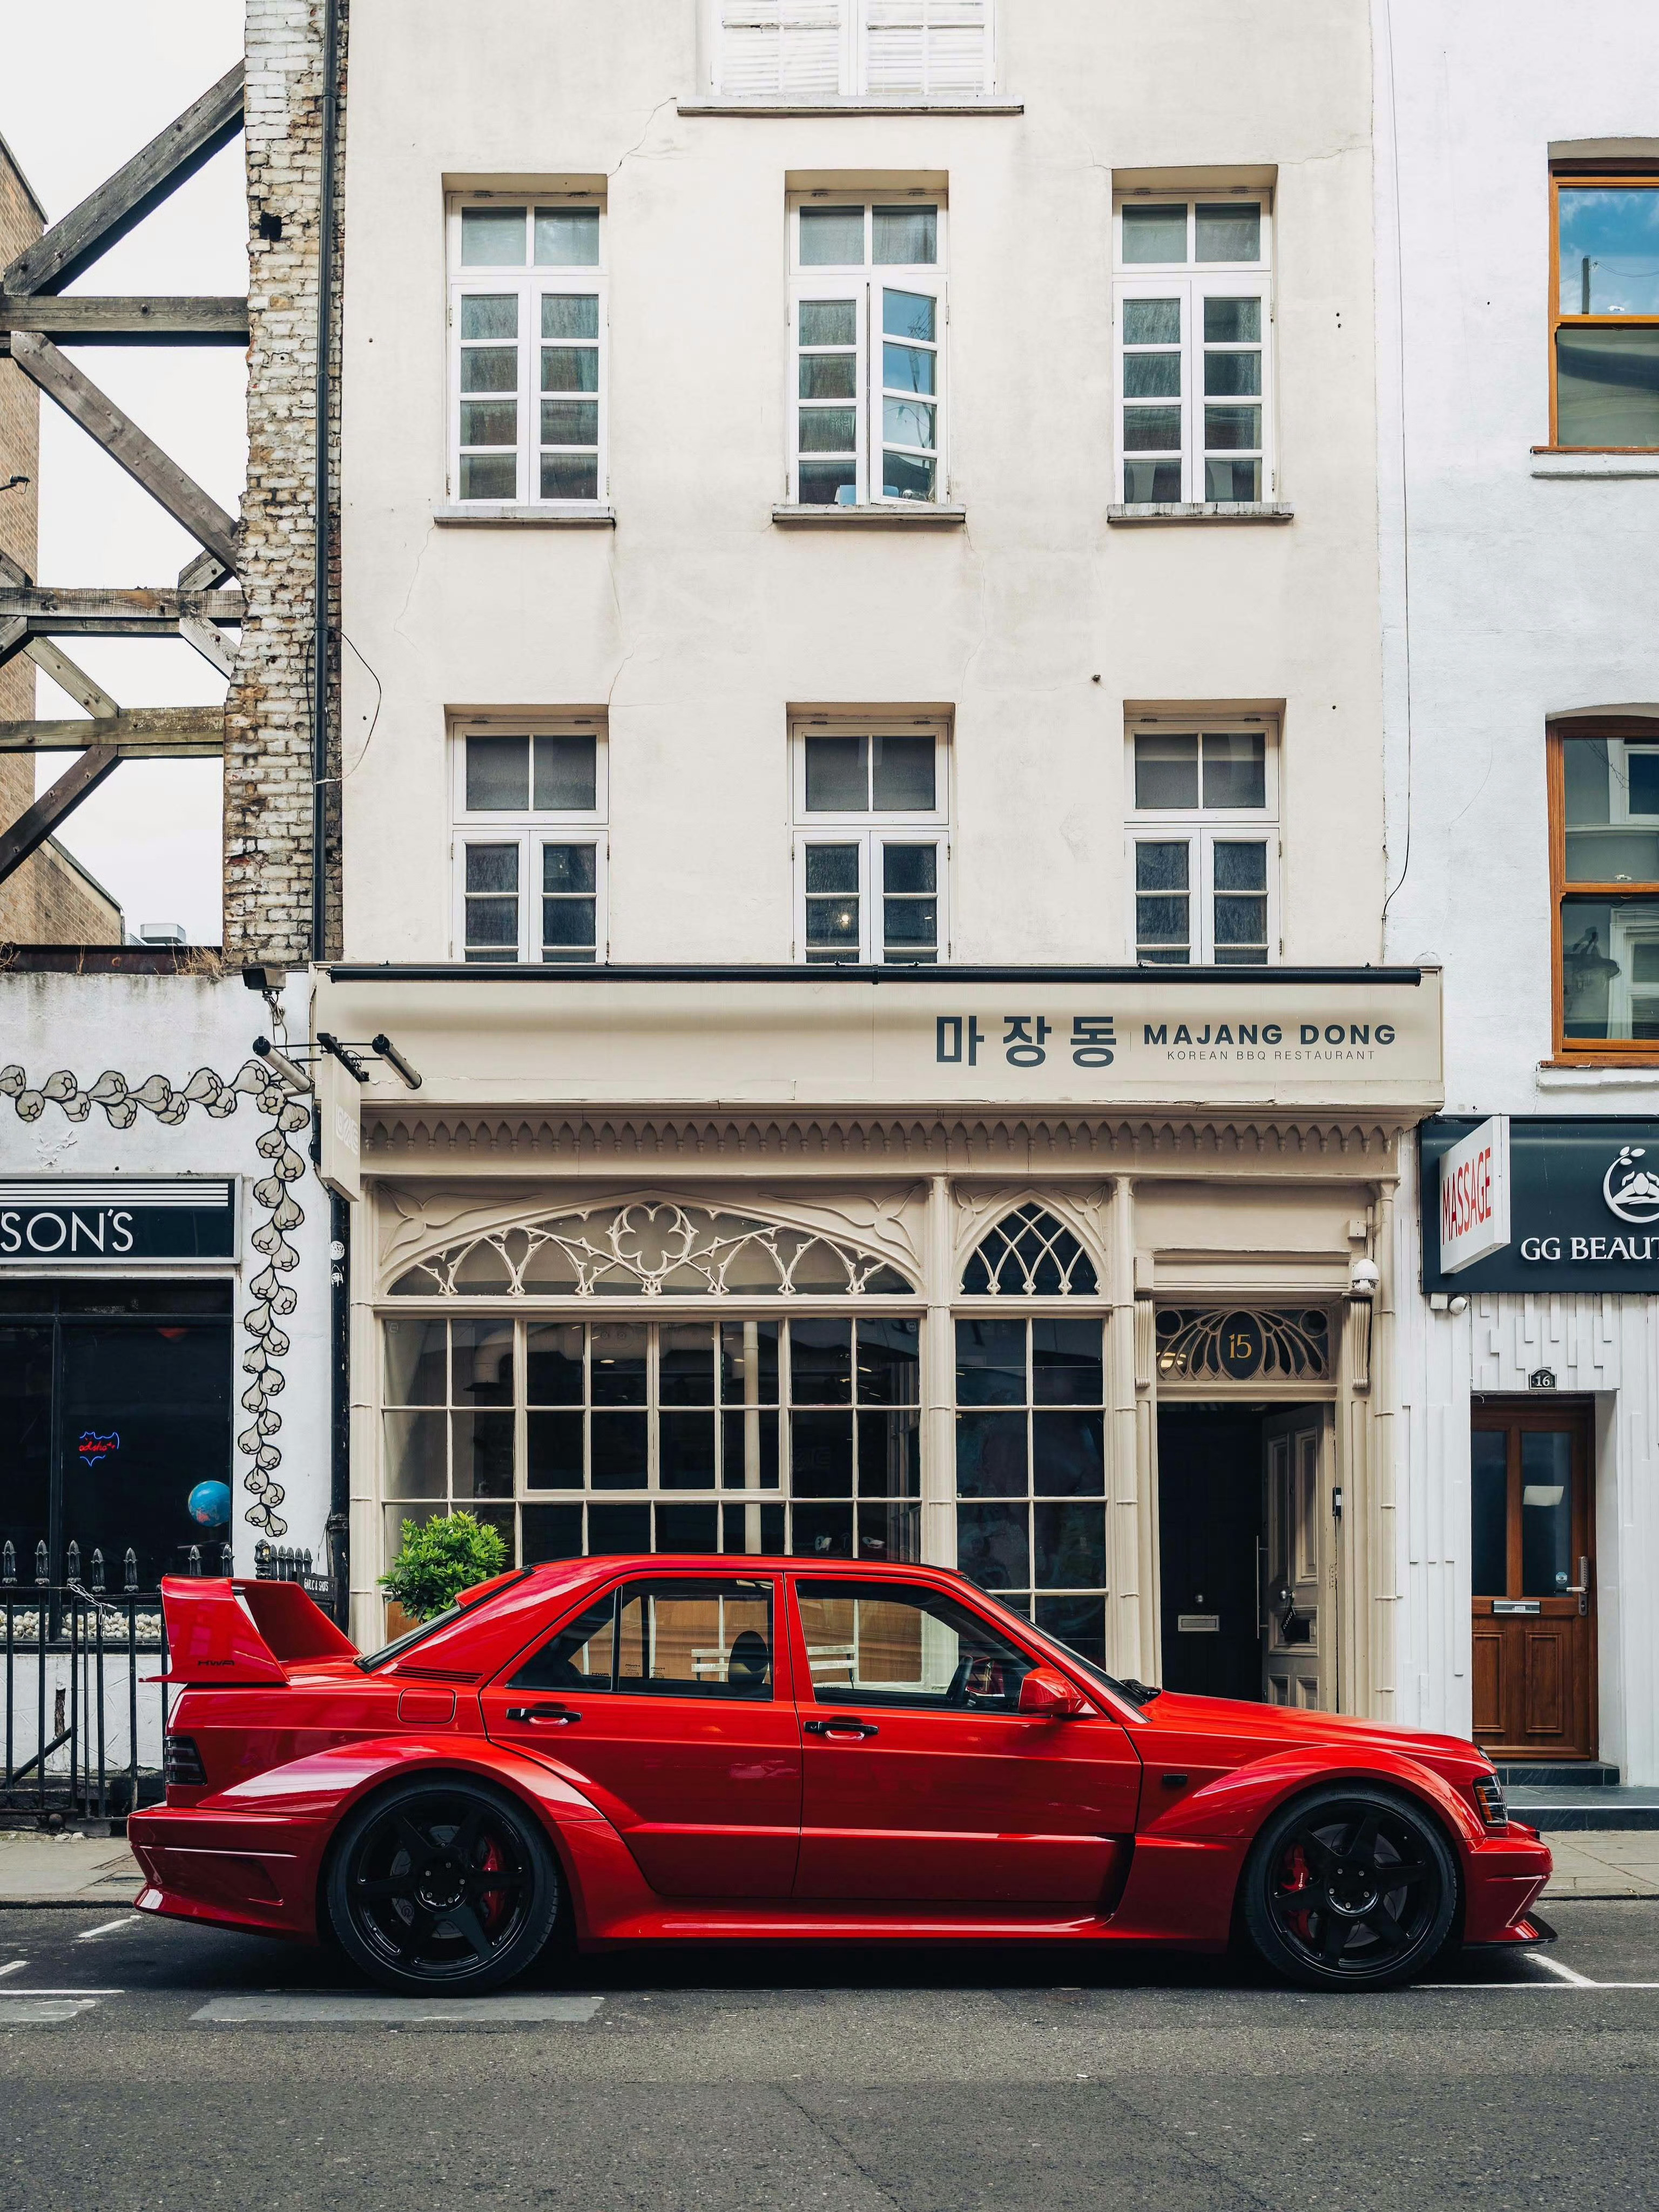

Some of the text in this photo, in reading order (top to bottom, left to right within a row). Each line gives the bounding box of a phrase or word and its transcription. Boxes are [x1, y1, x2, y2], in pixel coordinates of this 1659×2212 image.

[936, 1015, 1117, 1068] 마장동
[1144, 1024, 1395, 1045] MAJANG DONG
[1167, 1050, 1375, 1061] KOREAN BBQ RESTAURANT
[1442, 1147, 1491, 1245] MASSAGE
[1, 1209, 133, 1252] SON'S
[1520, 1237, 1560, 1260] GG
[1229, 1333, 1252, 1358] 15
[1535, 1375, 1550, 1387] 16
